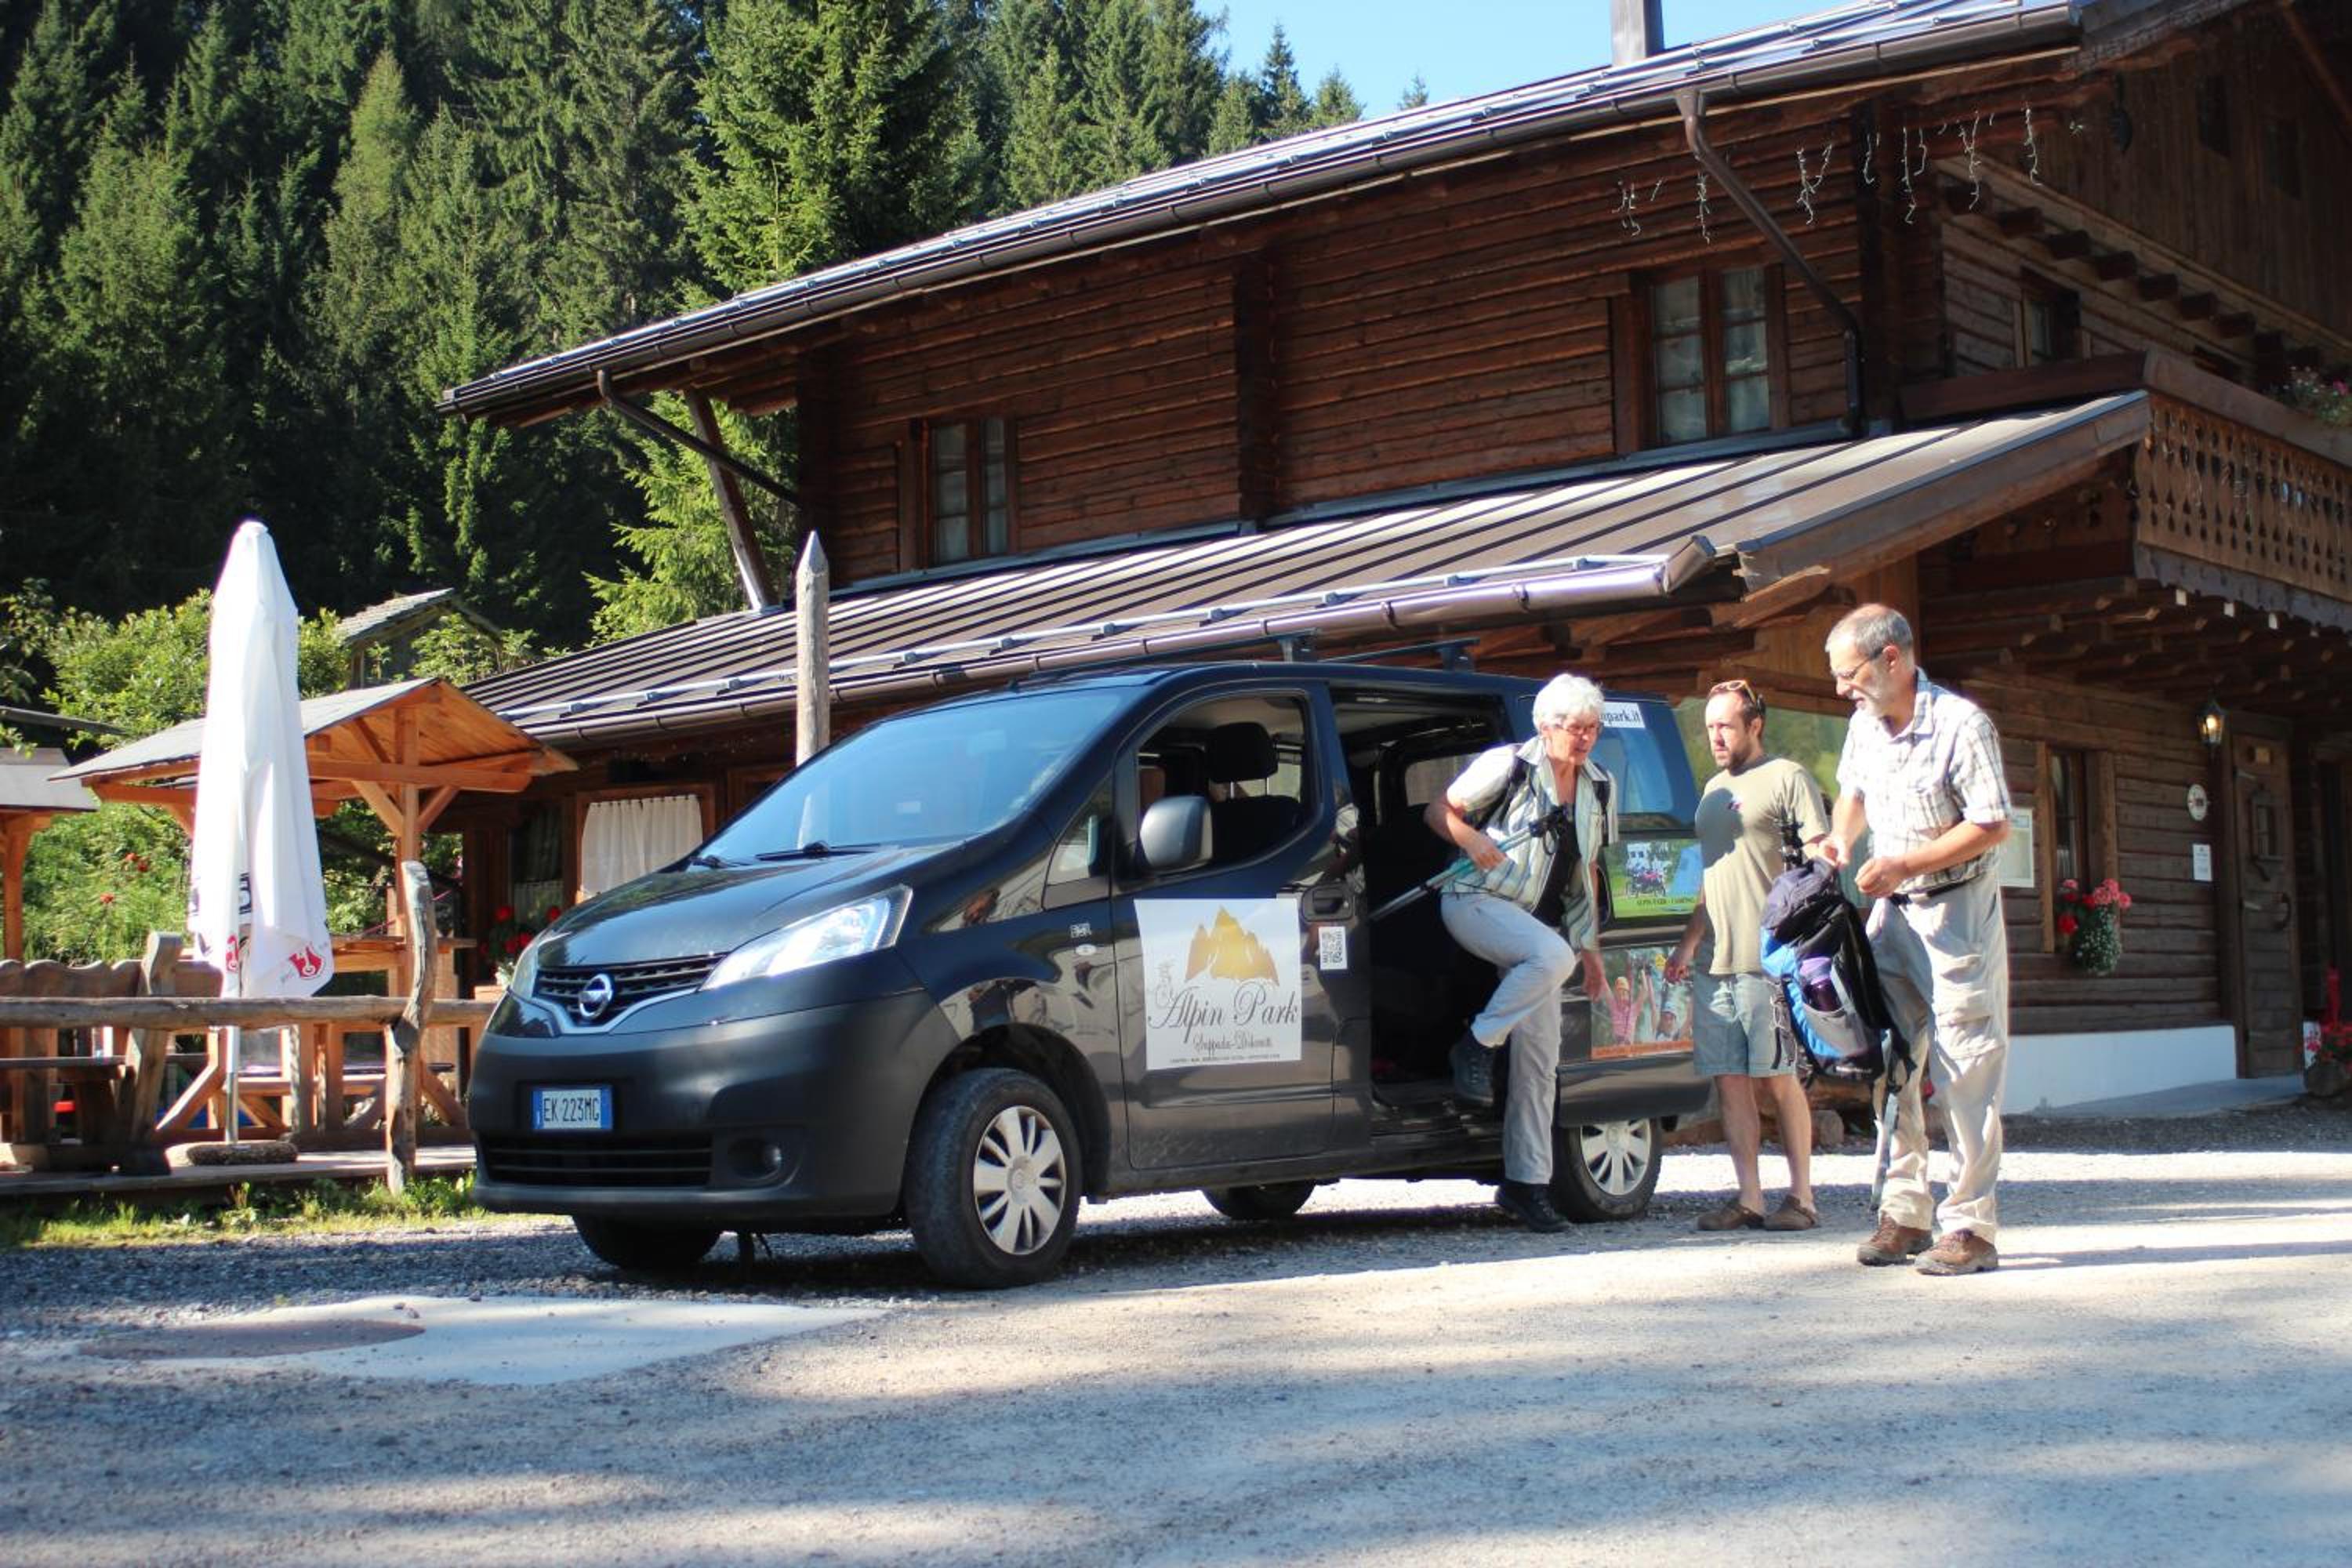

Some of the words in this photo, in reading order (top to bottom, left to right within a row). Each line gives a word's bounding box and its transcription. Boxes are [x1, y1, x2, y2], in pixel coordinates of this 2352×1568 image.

[1148, 985, 1223, 1044] Alpin
[1233, 981, 1298, 1026] Park
[543, 1098, 558, 1121] EK
